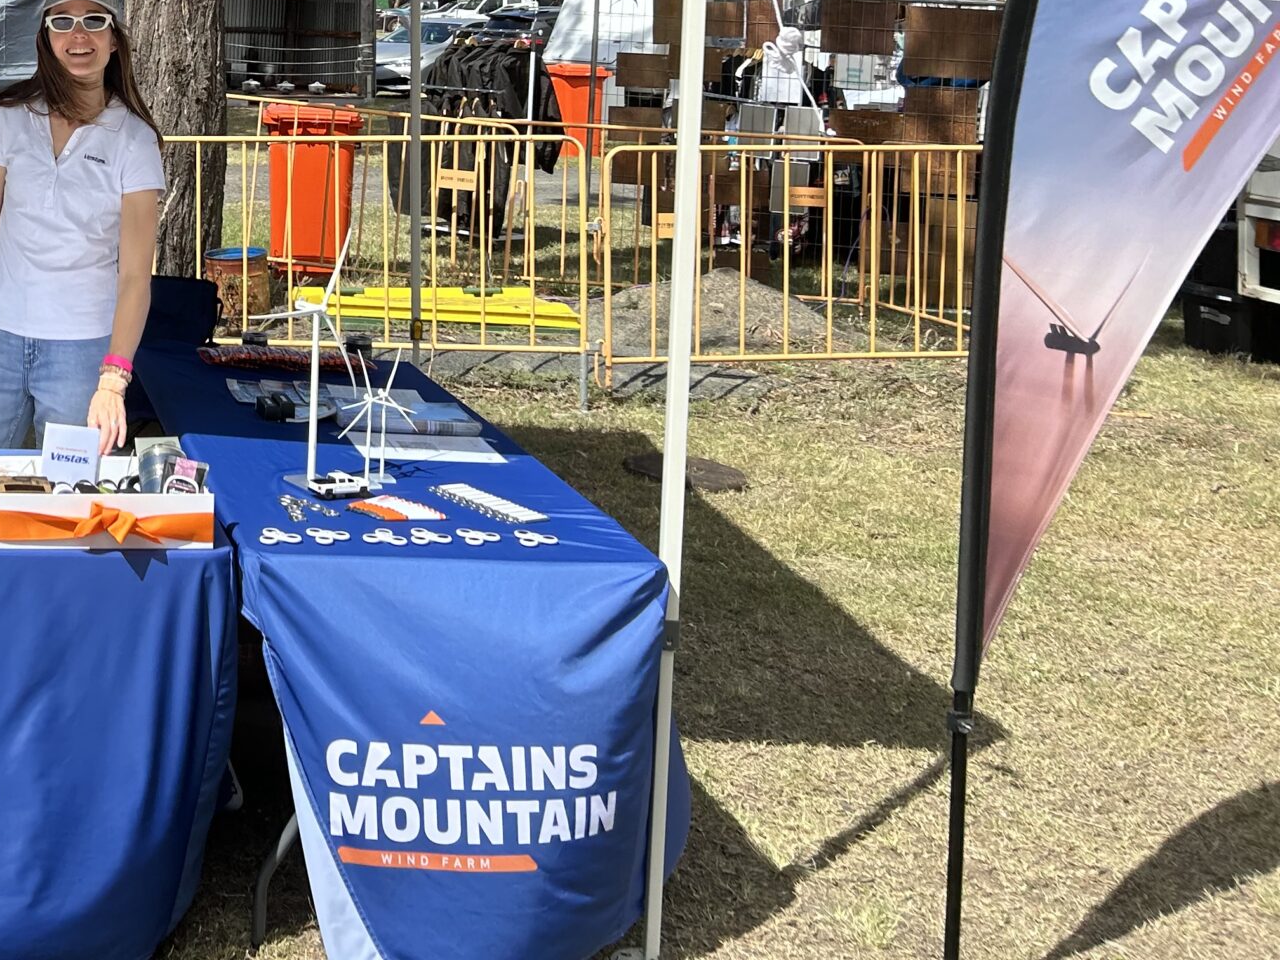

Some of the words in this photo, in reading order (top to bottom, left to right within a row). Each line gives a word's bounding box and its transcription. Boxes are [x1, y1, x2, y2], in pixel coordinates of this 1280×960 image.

[1213, 71, 1253, 121] WIND
[325, 739, 598, 791] CAPTAINS
[329, 791, 617, 845] MOUNTAIN
[381, 853, 429, 866] WIND
[442, 856, 491, 869] FARM
